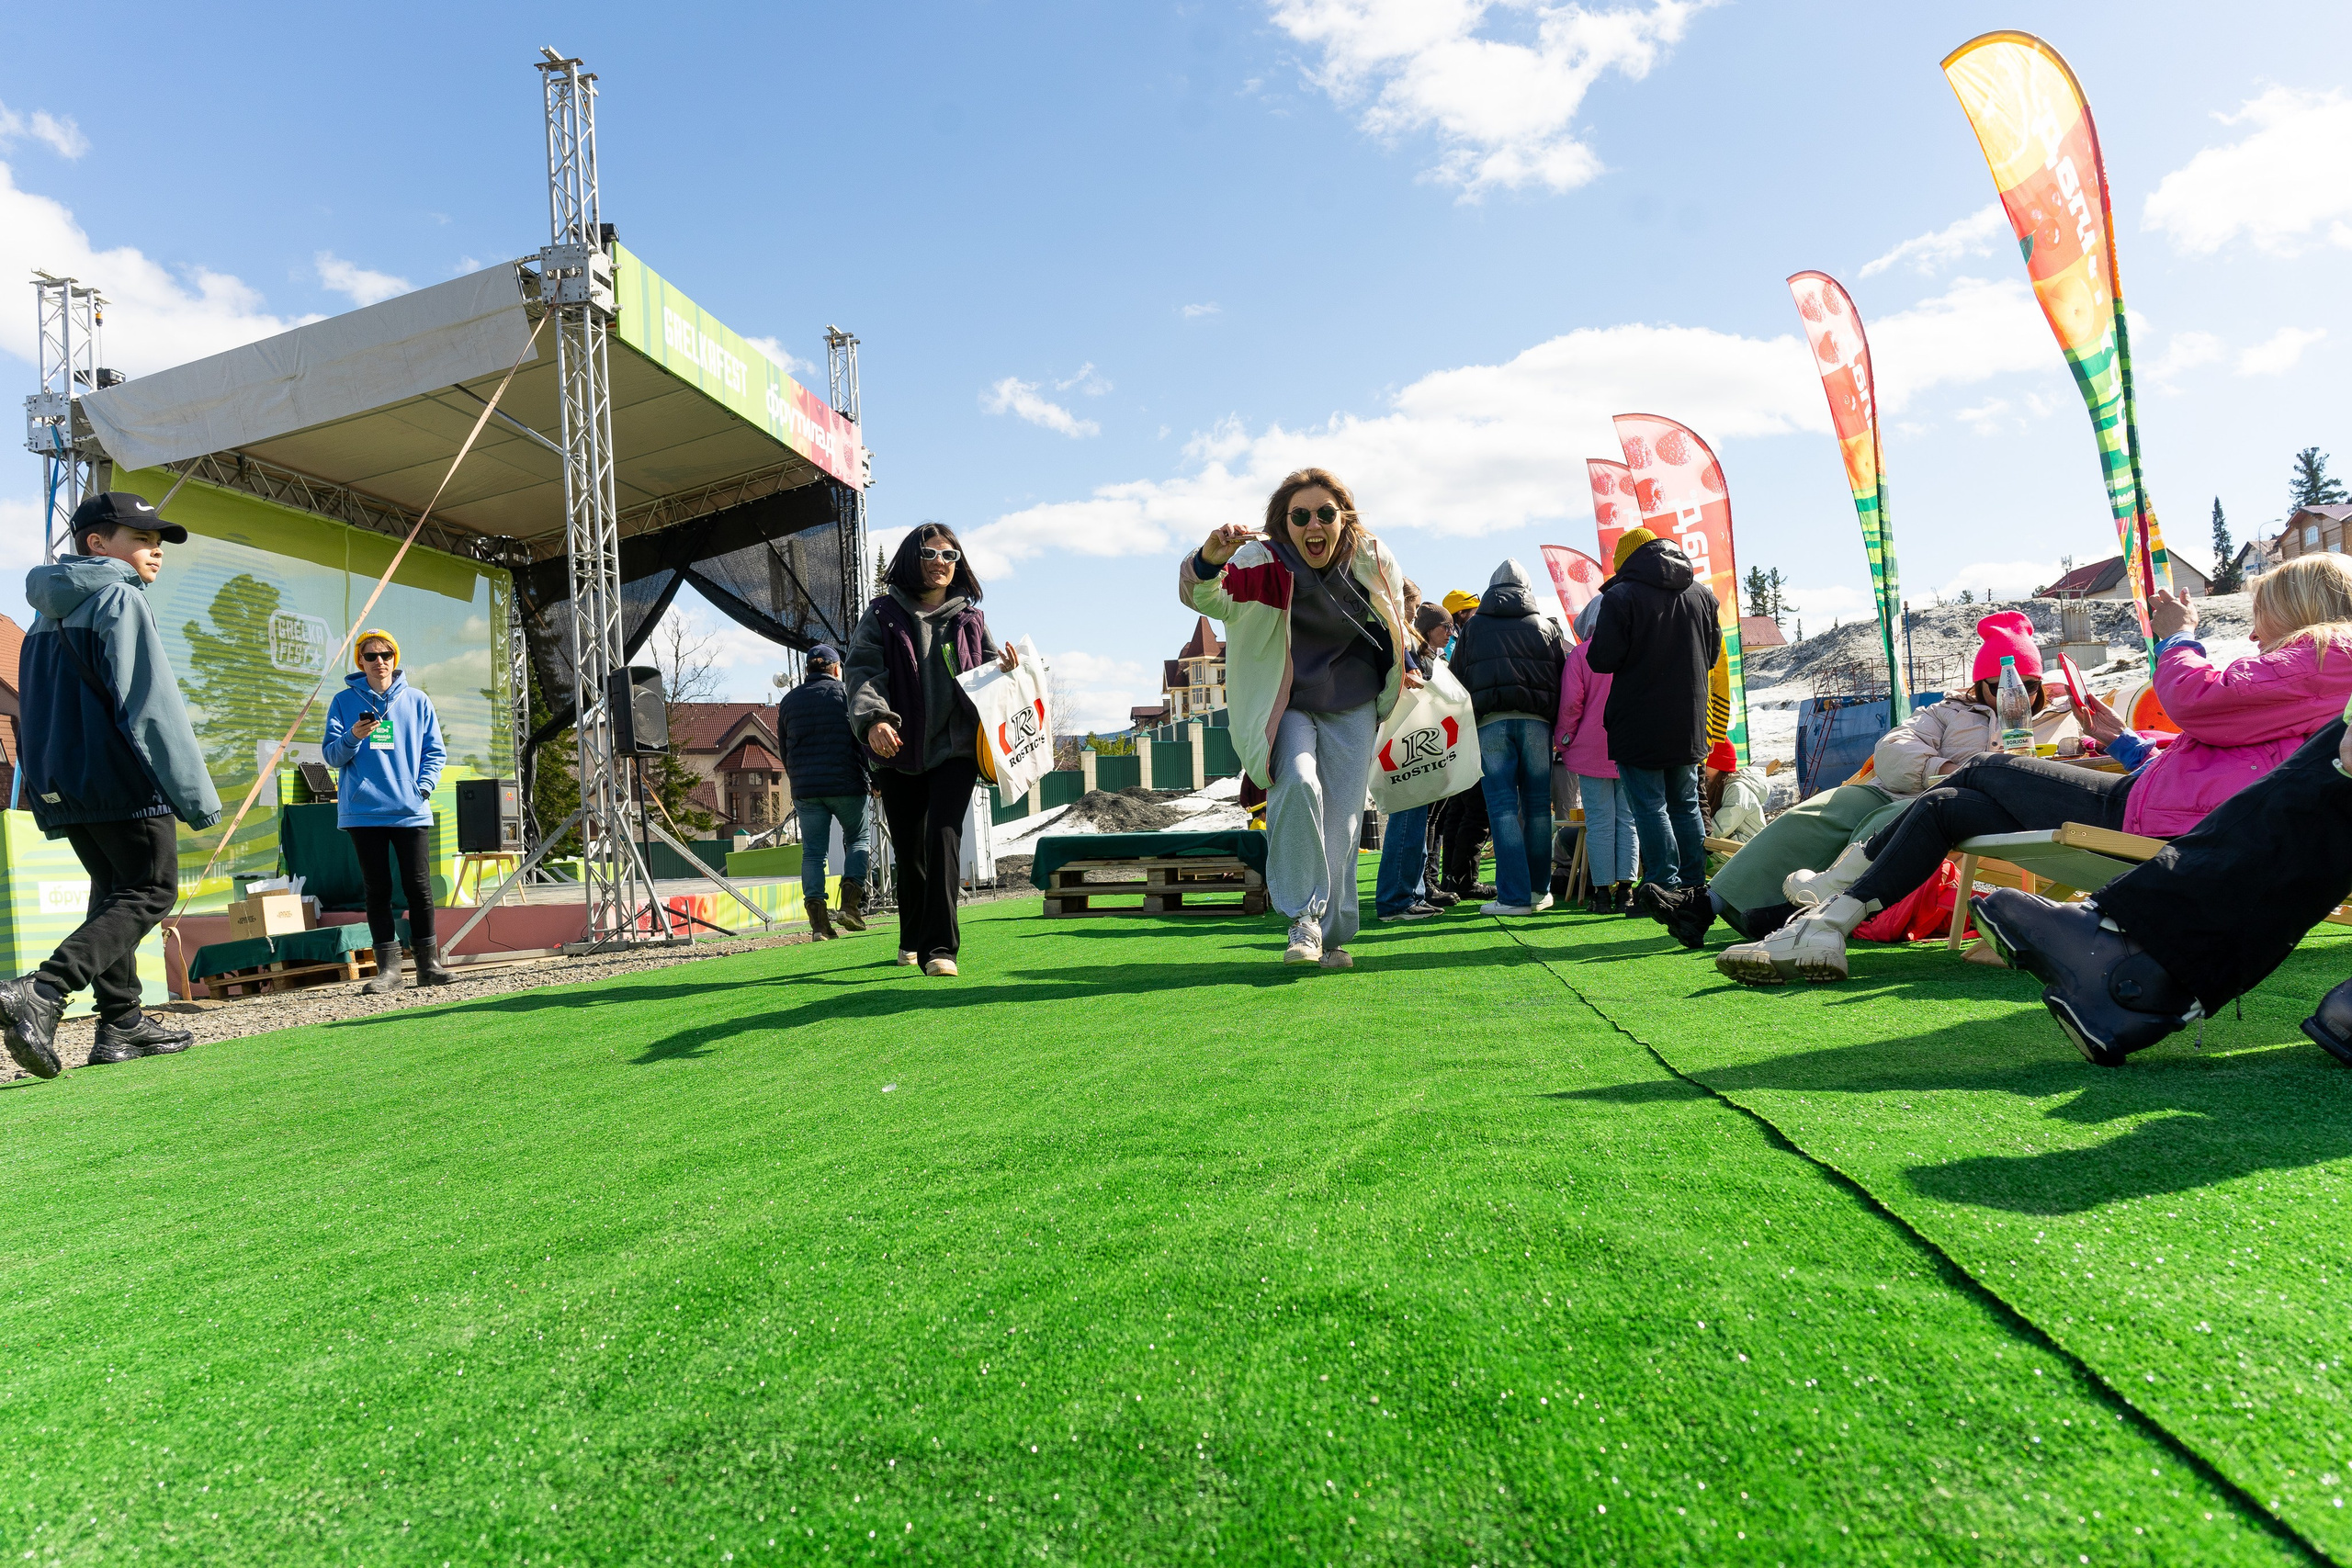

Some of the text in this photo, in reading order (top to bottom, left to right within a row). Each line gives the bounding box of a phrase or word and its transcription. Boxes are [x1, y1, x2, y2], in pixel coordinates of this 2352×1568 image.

[663, 306, 748, 398] GRELKAFEST
[765, 383, 836, 457] фрутилад
[277, 618, 324, 645] GRELKA
[278, 641, 311, 665] FEST
[1011, 706, 1036, 750] R
[1009, 734, 1046, 768] ROSTIC'S
[1401, 728, 1444, 768] R
[1389, 750, 1457, 785] ROSTIC'S
